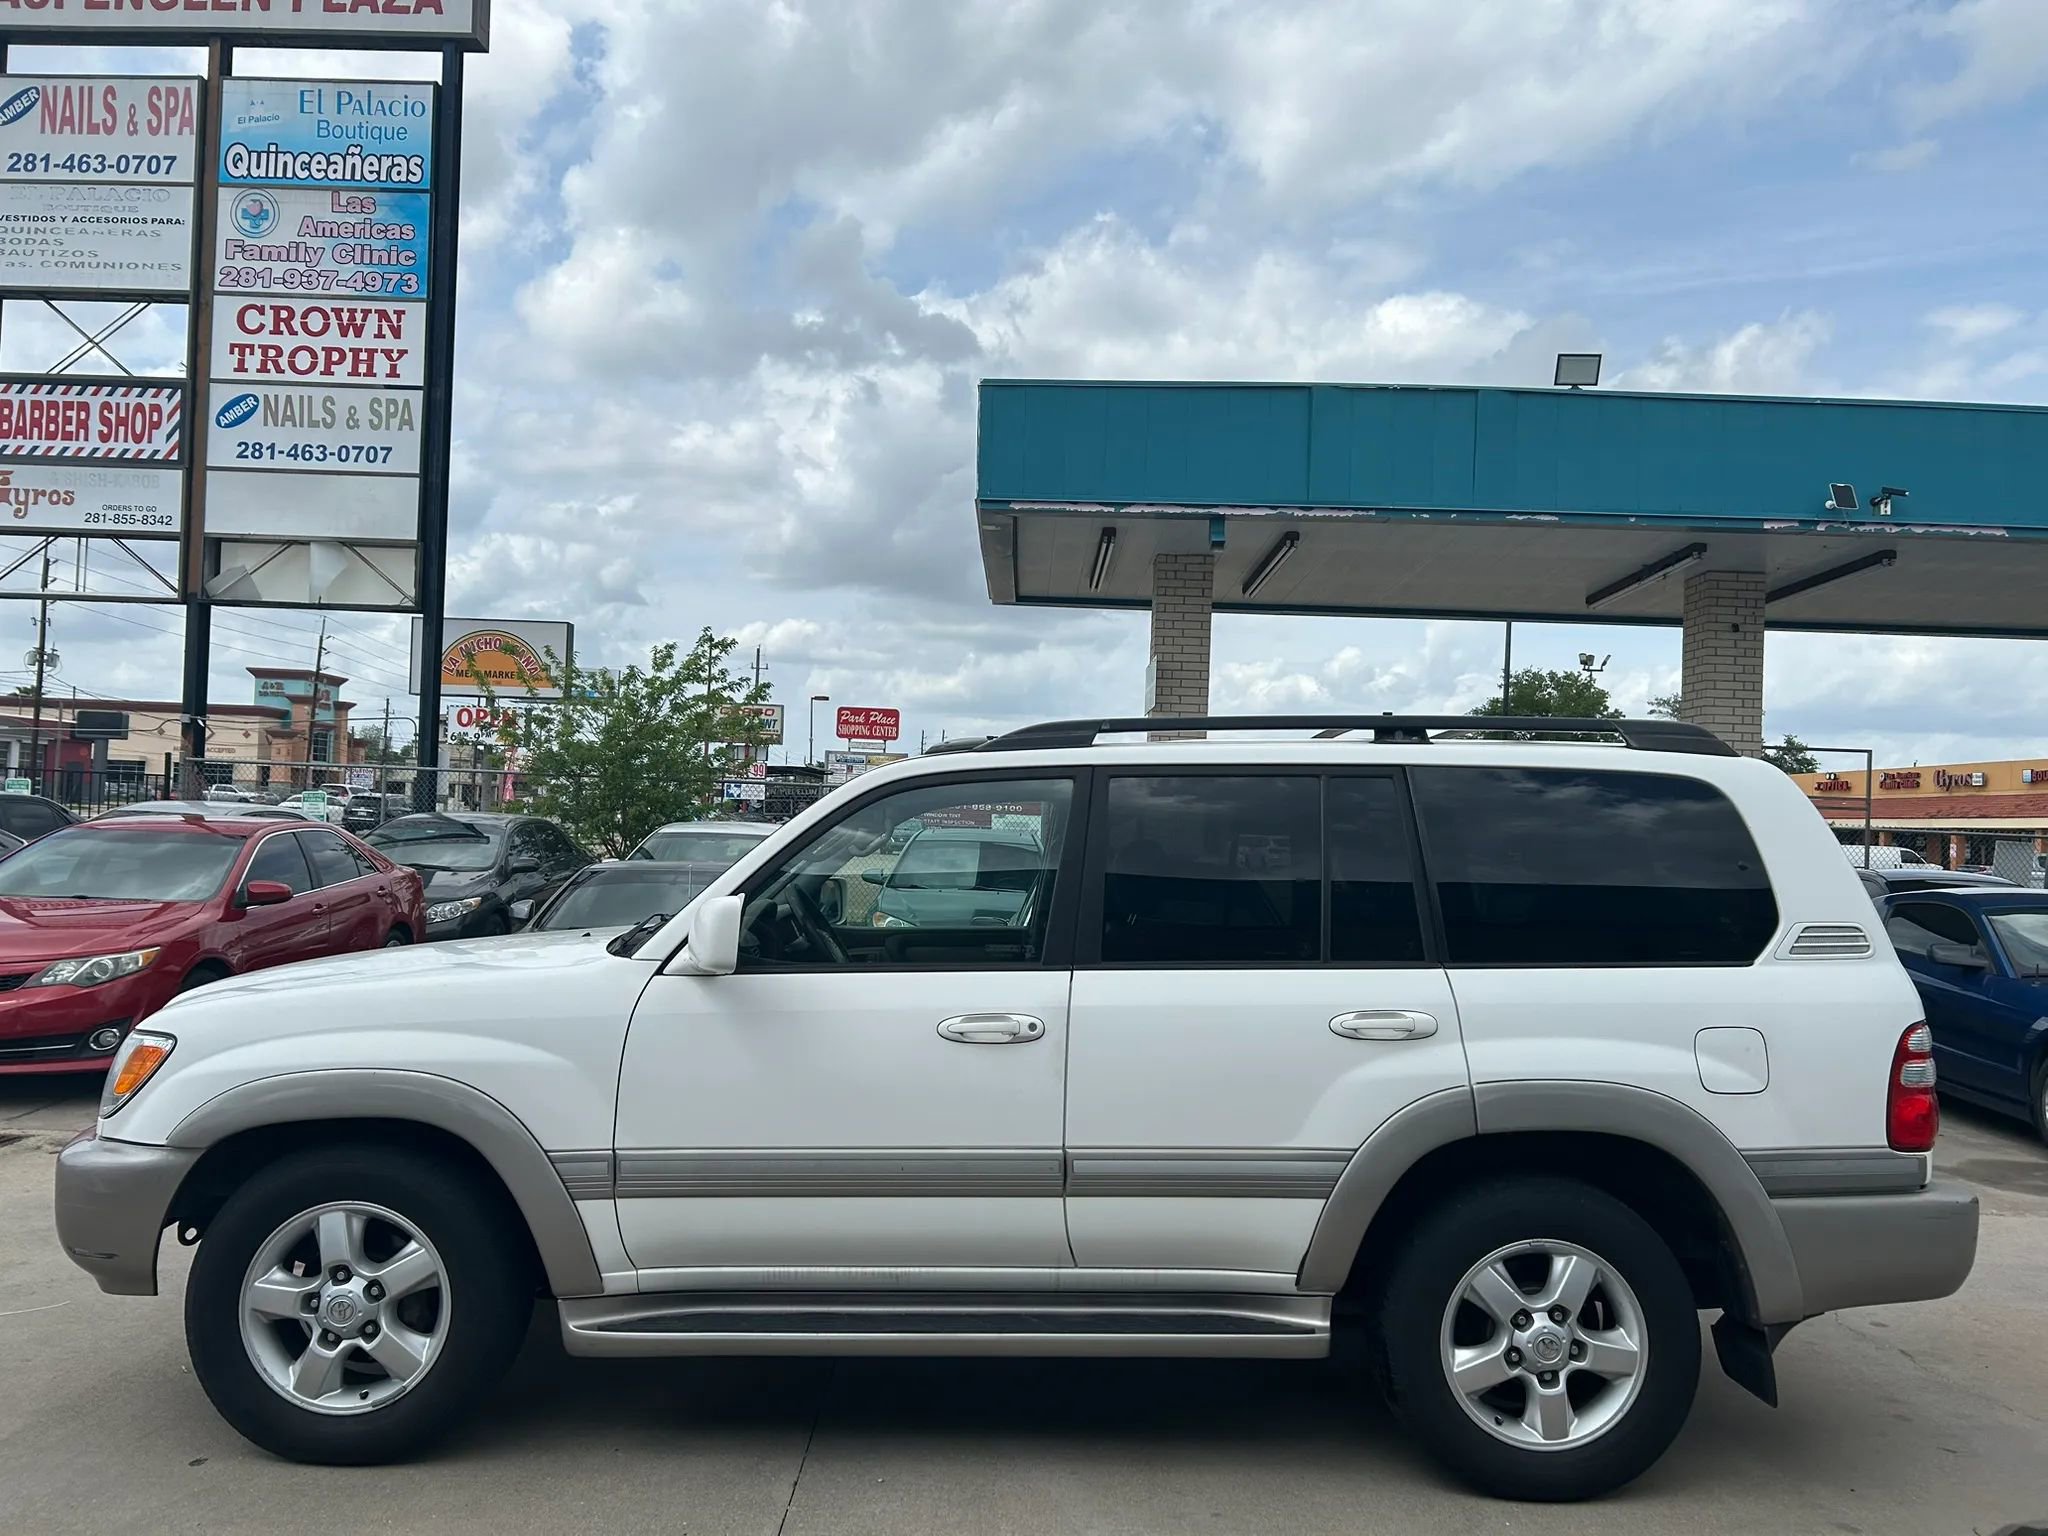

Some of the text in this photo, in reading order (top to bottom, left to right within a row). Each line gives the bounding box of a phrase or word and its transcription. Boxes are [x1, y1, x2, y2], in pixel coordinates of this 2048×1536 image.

[0, 89, 39, 125] AMBER
[40, 85, 195, 136] NAILS & SPA
[299, 89, 324, 115] El
[238, 113, 280, 125] El Palacio
[317, 119, 408, 145] Boutique
[7, 153, 177, 175] 281-463-0707
[225, 142, 424, 183] Quinceañeras
[331, 191, 376, 214] Las
[72, 215, 148, 225] ACCESORIOS
[151, 217, 185, 225] PARA:
[297, 216, 415, 240] Americas
[40, 260, 182, 271] COMUNIONES
[225, 239, 417, 268] Family Clinic
[219, 266, 419, 294] 281-937-4973
[236, 303, 406, 339] CROWN
[229, 343, 409, 378] TROPHY
[0, 399, 163, 444] BARBER SHOP
[218, 396, 258, 426] AMBER
[263, 394, 414, 431] NAILS & SPA
[235, 441, 393, 464] 281-463-0707
[84, 513, 173, 526] 281-855-8342
[102, 504, 132, 512] ORDERS
[442, 636, 541, 677] LA MICHOANA
[456, 670, 519, 680] MEA MARKE
[838, 724, 897, 737] SHOPPING CENTER
[840, 710, 896, 725] Park Place
